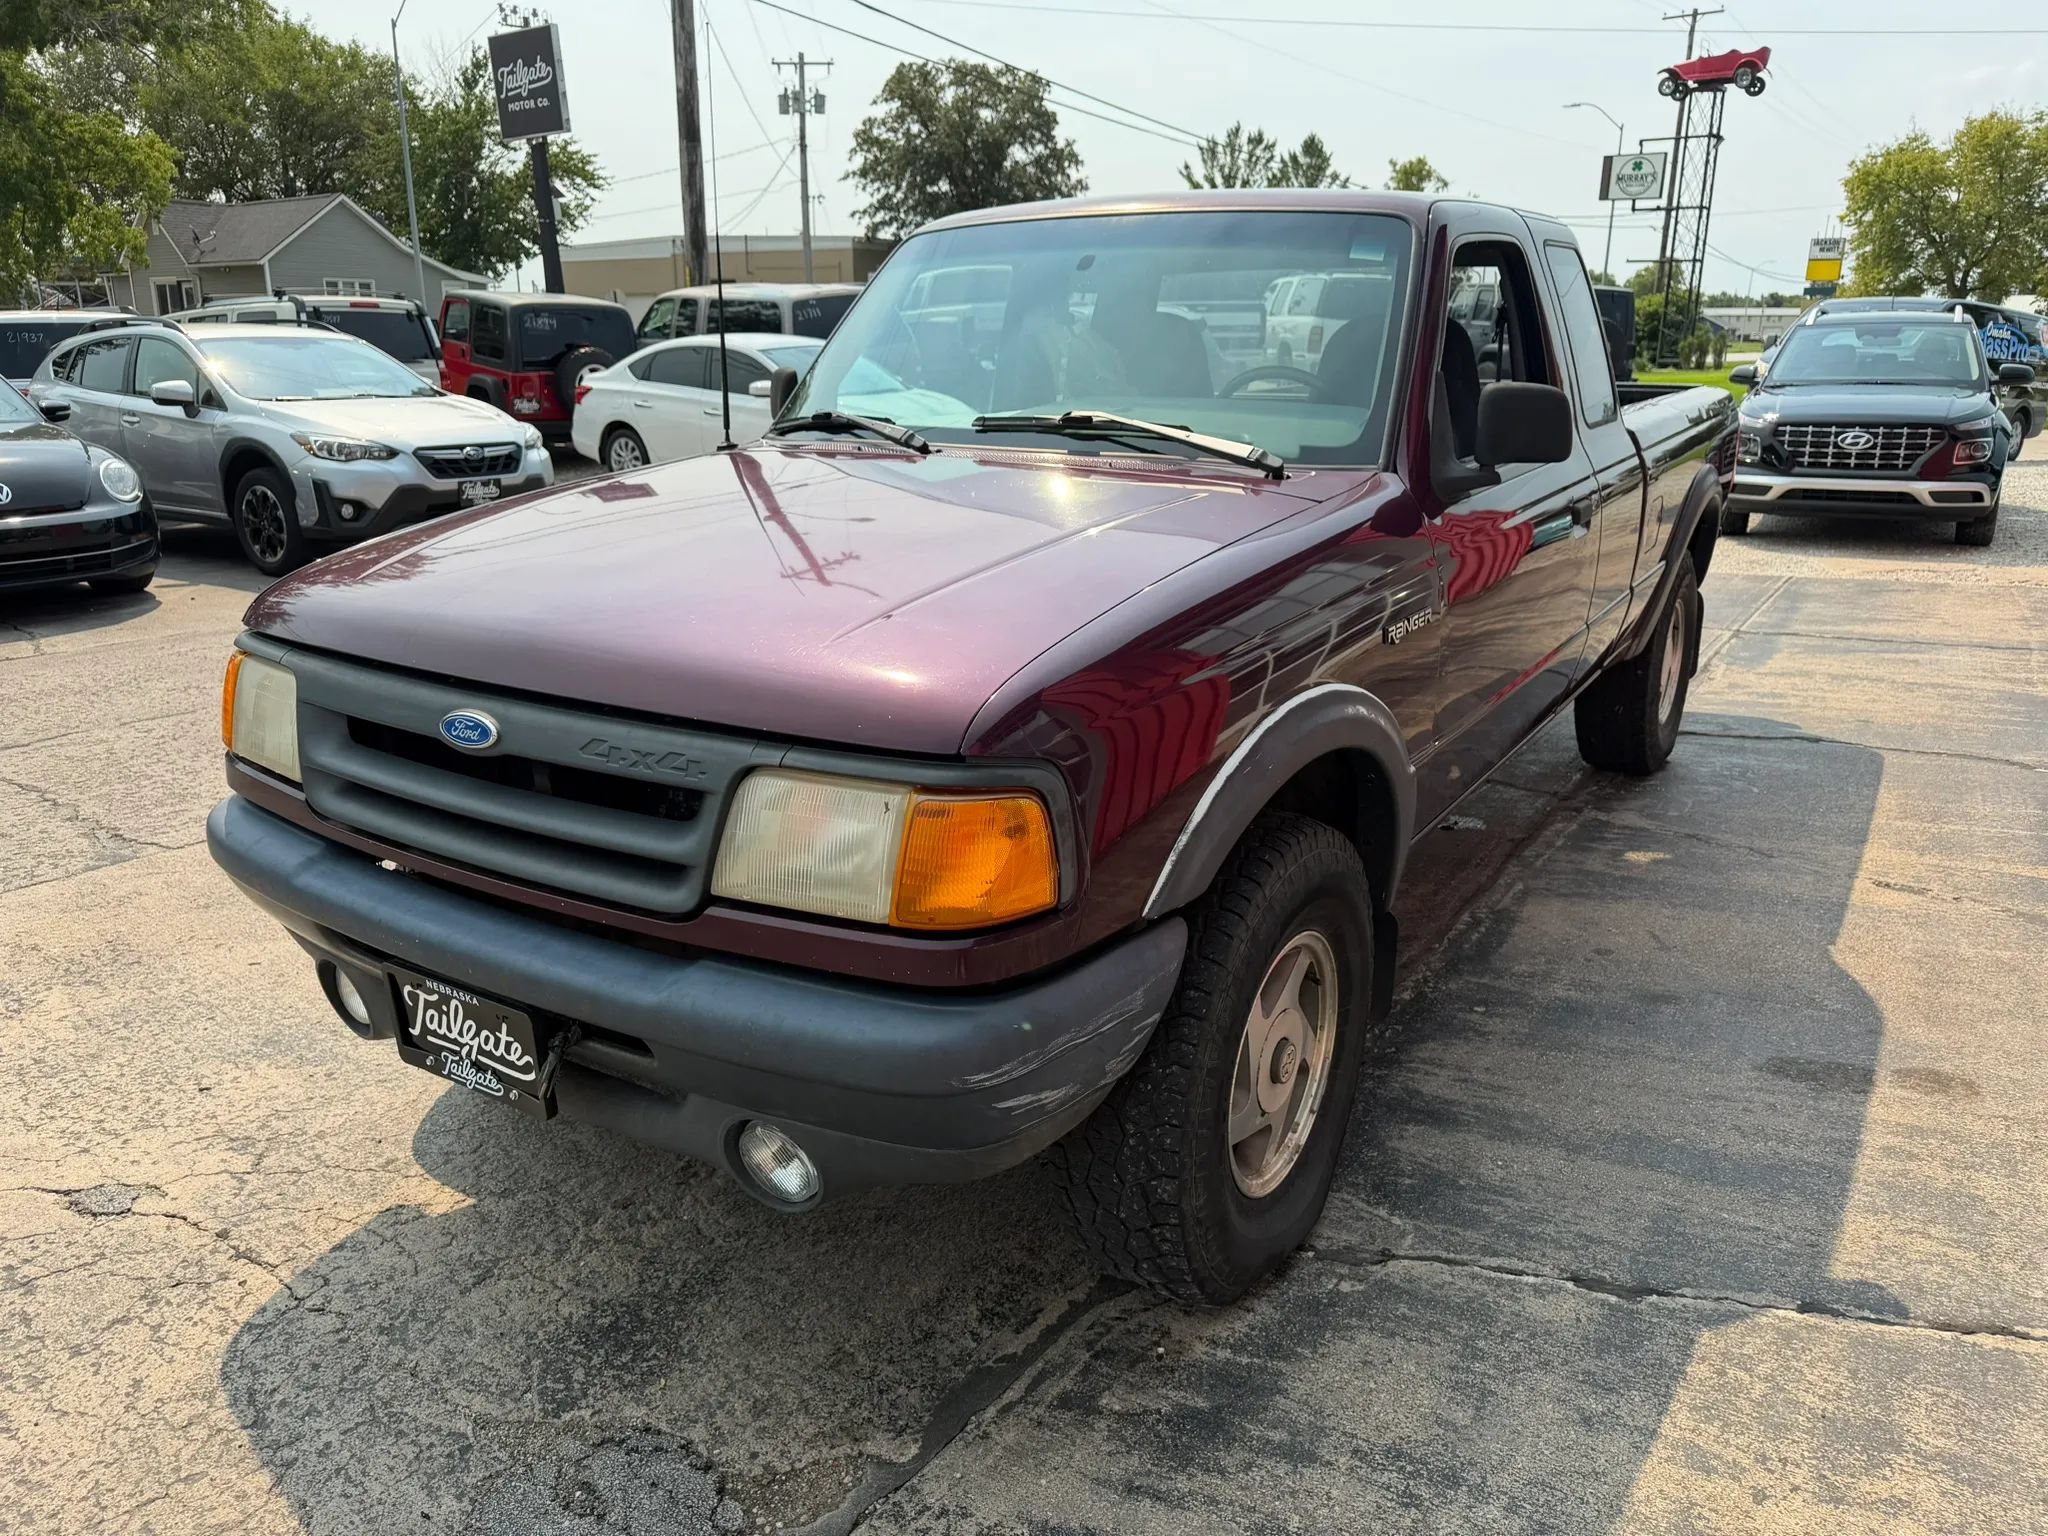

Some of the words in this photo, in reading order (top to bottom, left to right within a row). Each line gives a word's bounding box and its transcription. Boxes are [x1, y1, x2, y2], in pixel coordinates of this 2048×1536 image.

[498, 54, 553, 99] Tailgate
[507, 99, 536, 112] MOTOR
[1615, 171, 1657, 185] MURRAY'S
[1813, 238, 1840, 246] JACKSON
[6, 331, 44, 343] 21937
[1986, 320, 2011, 340] Omaha
[1981, 333, 2029, 362] lassPro
[462, 480, 500, 500] Tailgate
[1387, 607, 1433, 644] RANGER
[450, 717, 481, 742] Ford
[578, 737, 710, 782] 4x4
[425, 979, 480, 1007] NEBRASKA
[403, 984, 536, 1081] Tailgate
[440, 1051, 505, 1097] Tailgate
